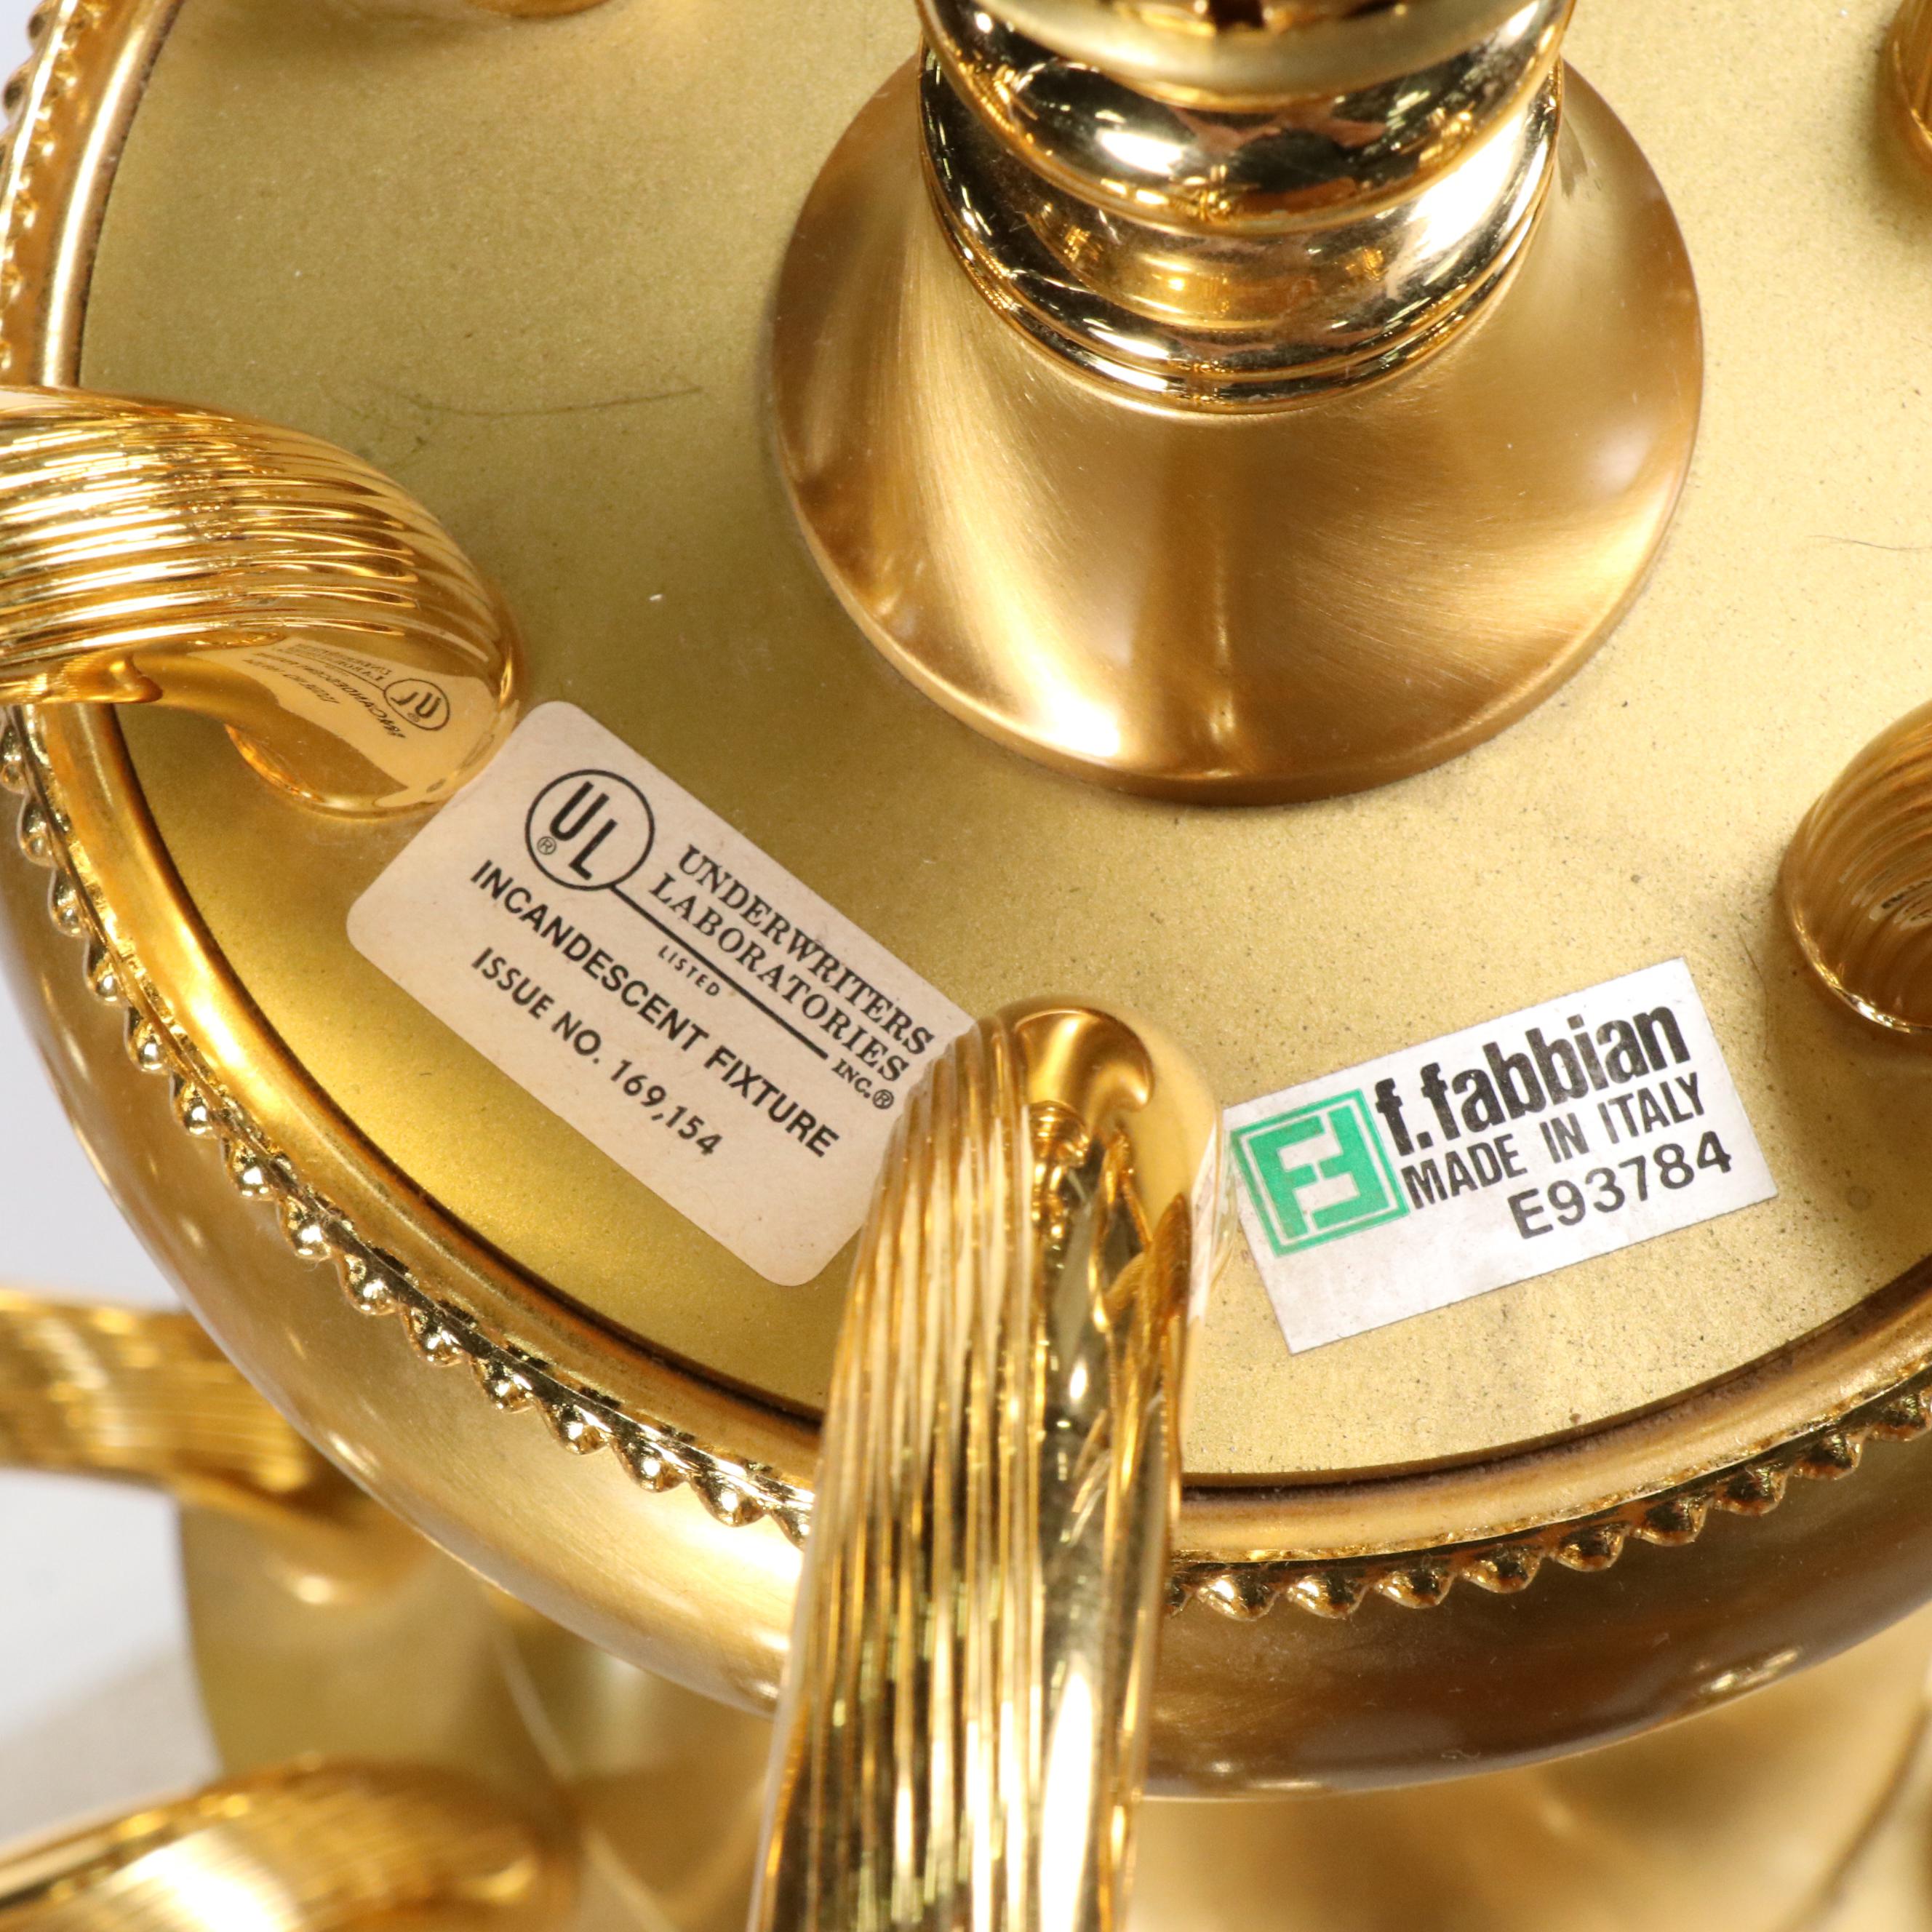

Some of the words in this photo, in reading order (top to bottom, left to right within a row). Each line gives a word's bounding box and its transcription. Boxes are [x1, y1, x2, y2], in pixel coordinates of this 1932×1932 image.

[550, 781, 619, 880] UL
[471, 861, 710, 1052] INCANDESCENT
[704, 1045, 840, 1158] FIXTURE
[649, 873, 911, 1084] LABORATORIES
[658, 946, 721, 998] LISTED
[678, 843, 935, 1056] UNDERWRITERS
[471, 947, 554, 1017] ISSUE
[552, 1011, 602, 1065] NO.
[610, 1058, 724, 1157] 169,154
[1400, 1133, 1527, 1210] MADE
[1539, 1111, 1589, 1162] IN
[1597, 1071, 1706, 1144] ITALY
[1507, 1131, 1731, 1240] E93784
